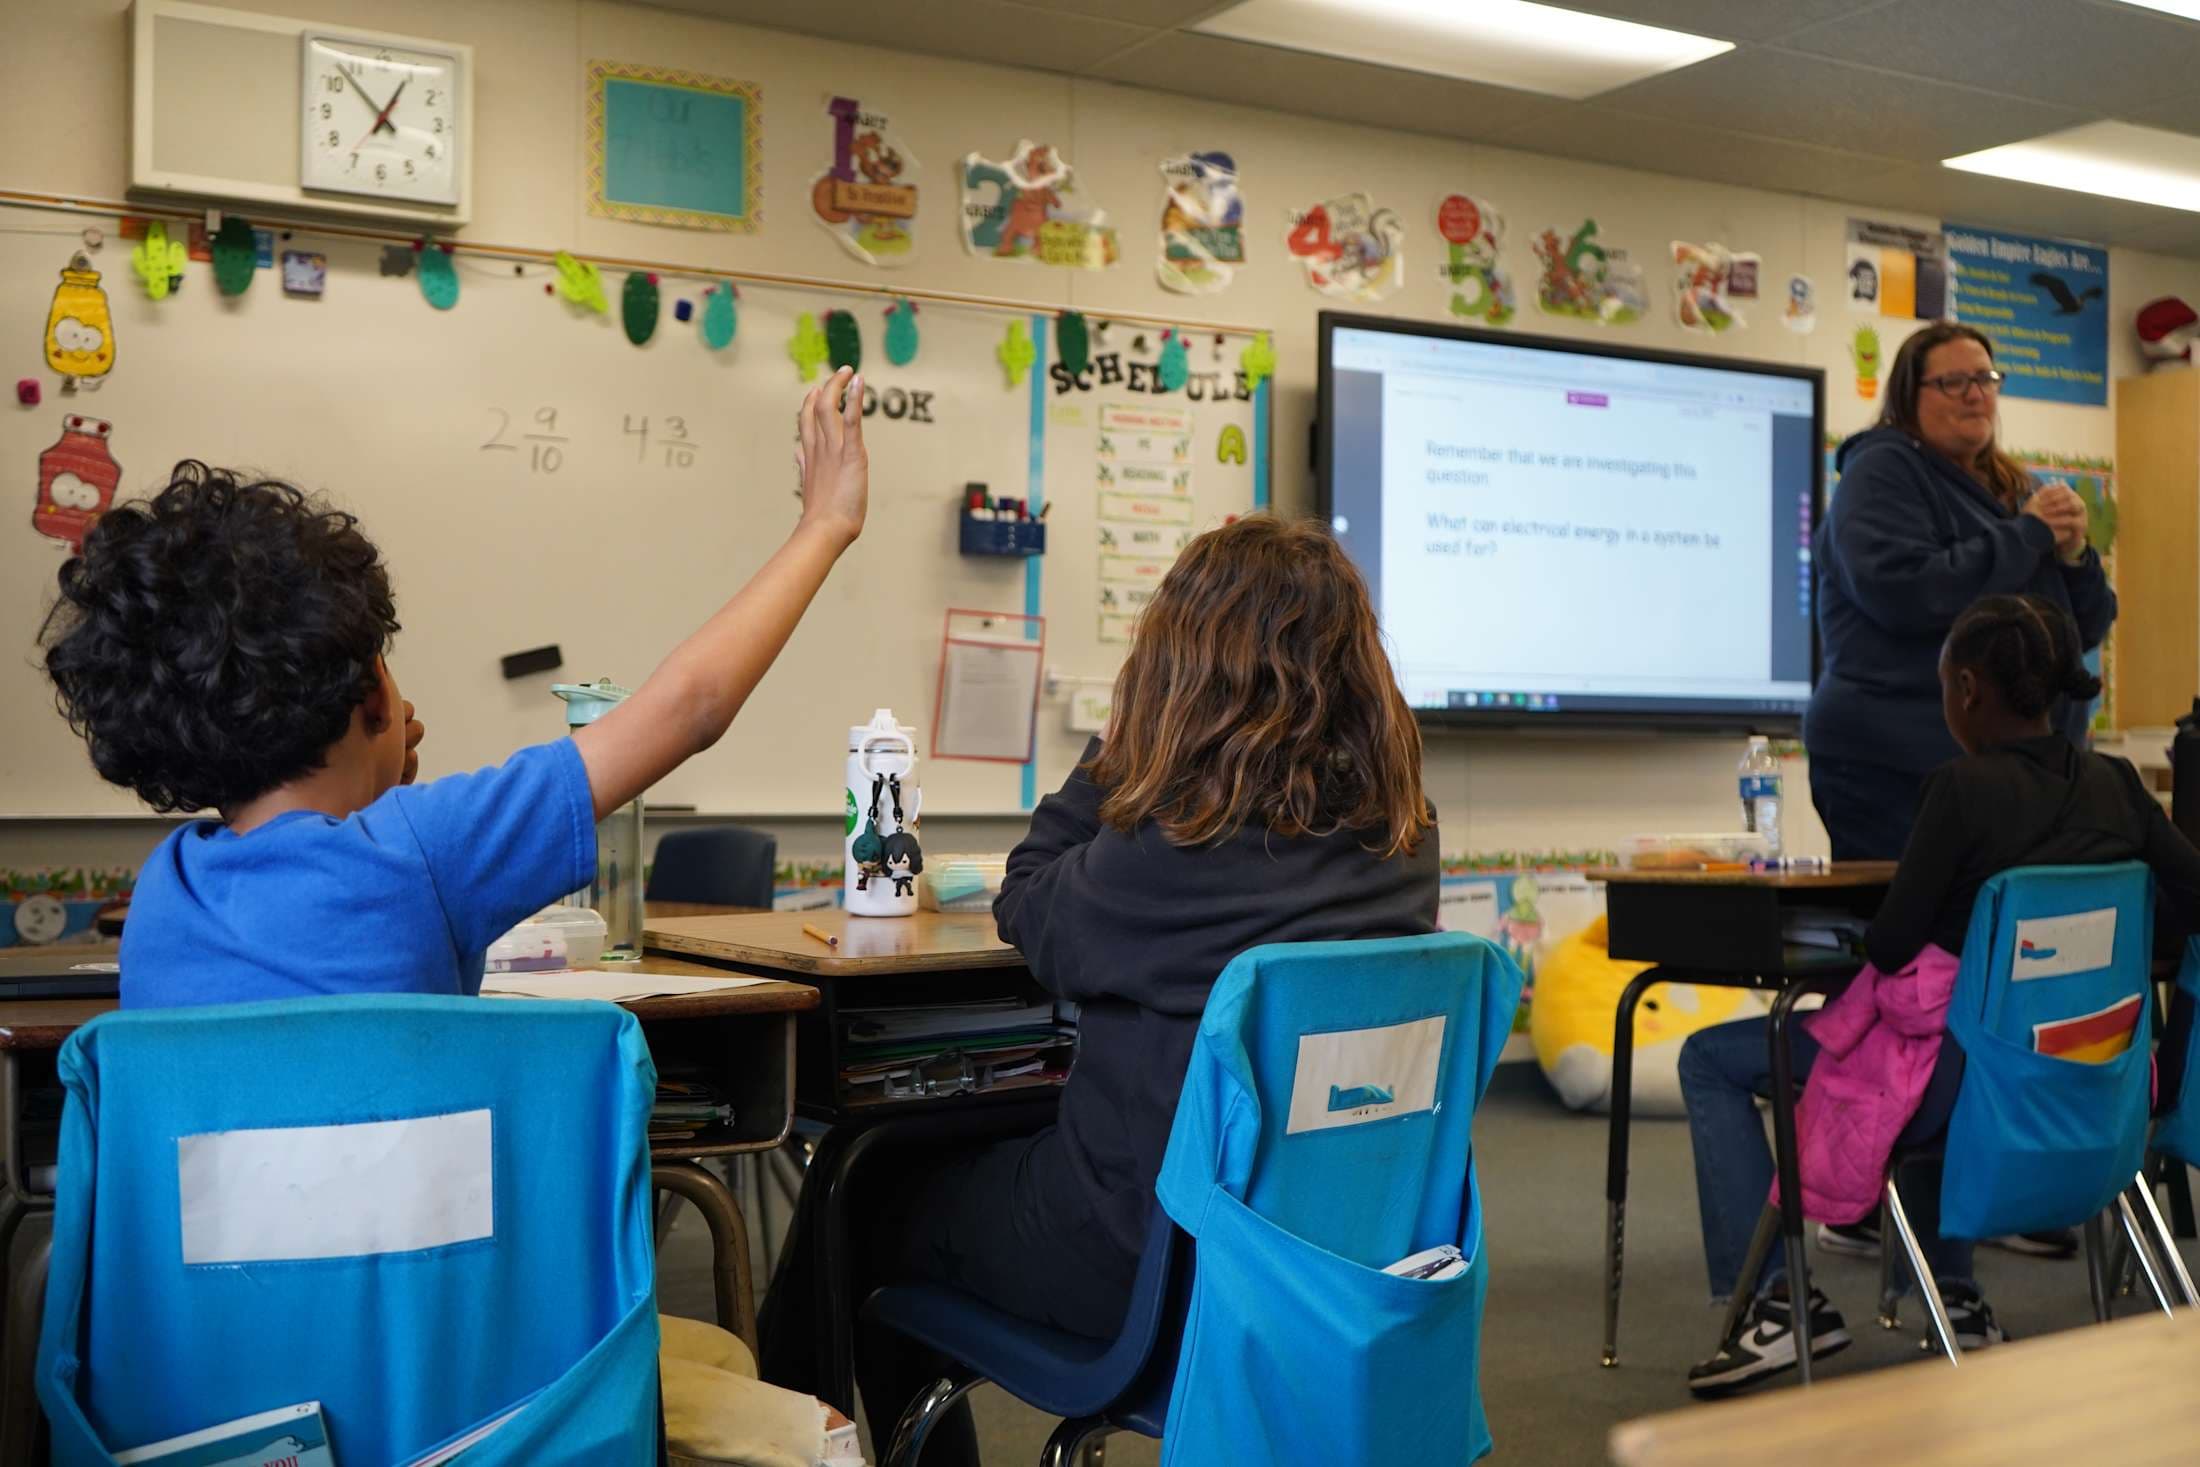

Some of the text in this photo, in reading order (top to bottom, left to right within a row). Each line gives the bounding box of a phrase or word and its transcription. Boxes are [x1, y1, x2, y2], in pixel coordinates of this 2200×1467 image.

[327, 76, 344, 93] 10
[426, 90, 437, 106] 2
[322, 103, 332, 119] 9
[434, 117, 443, 133] 3
[329, 131, 340, 147] 8
[350, 153, 360, 168] 7
[425, 146, 436, 159] 4
[376, 164, 387, 180] 6
[405, 160, 415, 175] 5
[535, 406, 558, 432] 9
[665, 416, 689, 439] 3
[480, 406, 518, 451] 2
[622, 414, 650, 464] 4
[1217, 424, 1248, 465] A
[530, 446, 563, 474] 10
[665, 447, 695, 470] 10
[1426, 439, 1697, 480] Remember that we are investigating this
[1426, 512, 1467, 530] What
[1472, 518, 1497, 533] can
[1502, 515, 1569, 538] electrical
[1574, 525, 1621, 544] energy
[1625, 528, 1639, 543] in
[1652, 530, 1702, 549] system
[1703, 531, 1720, 548] be
[1426, 539, 1499, 557] used for?
